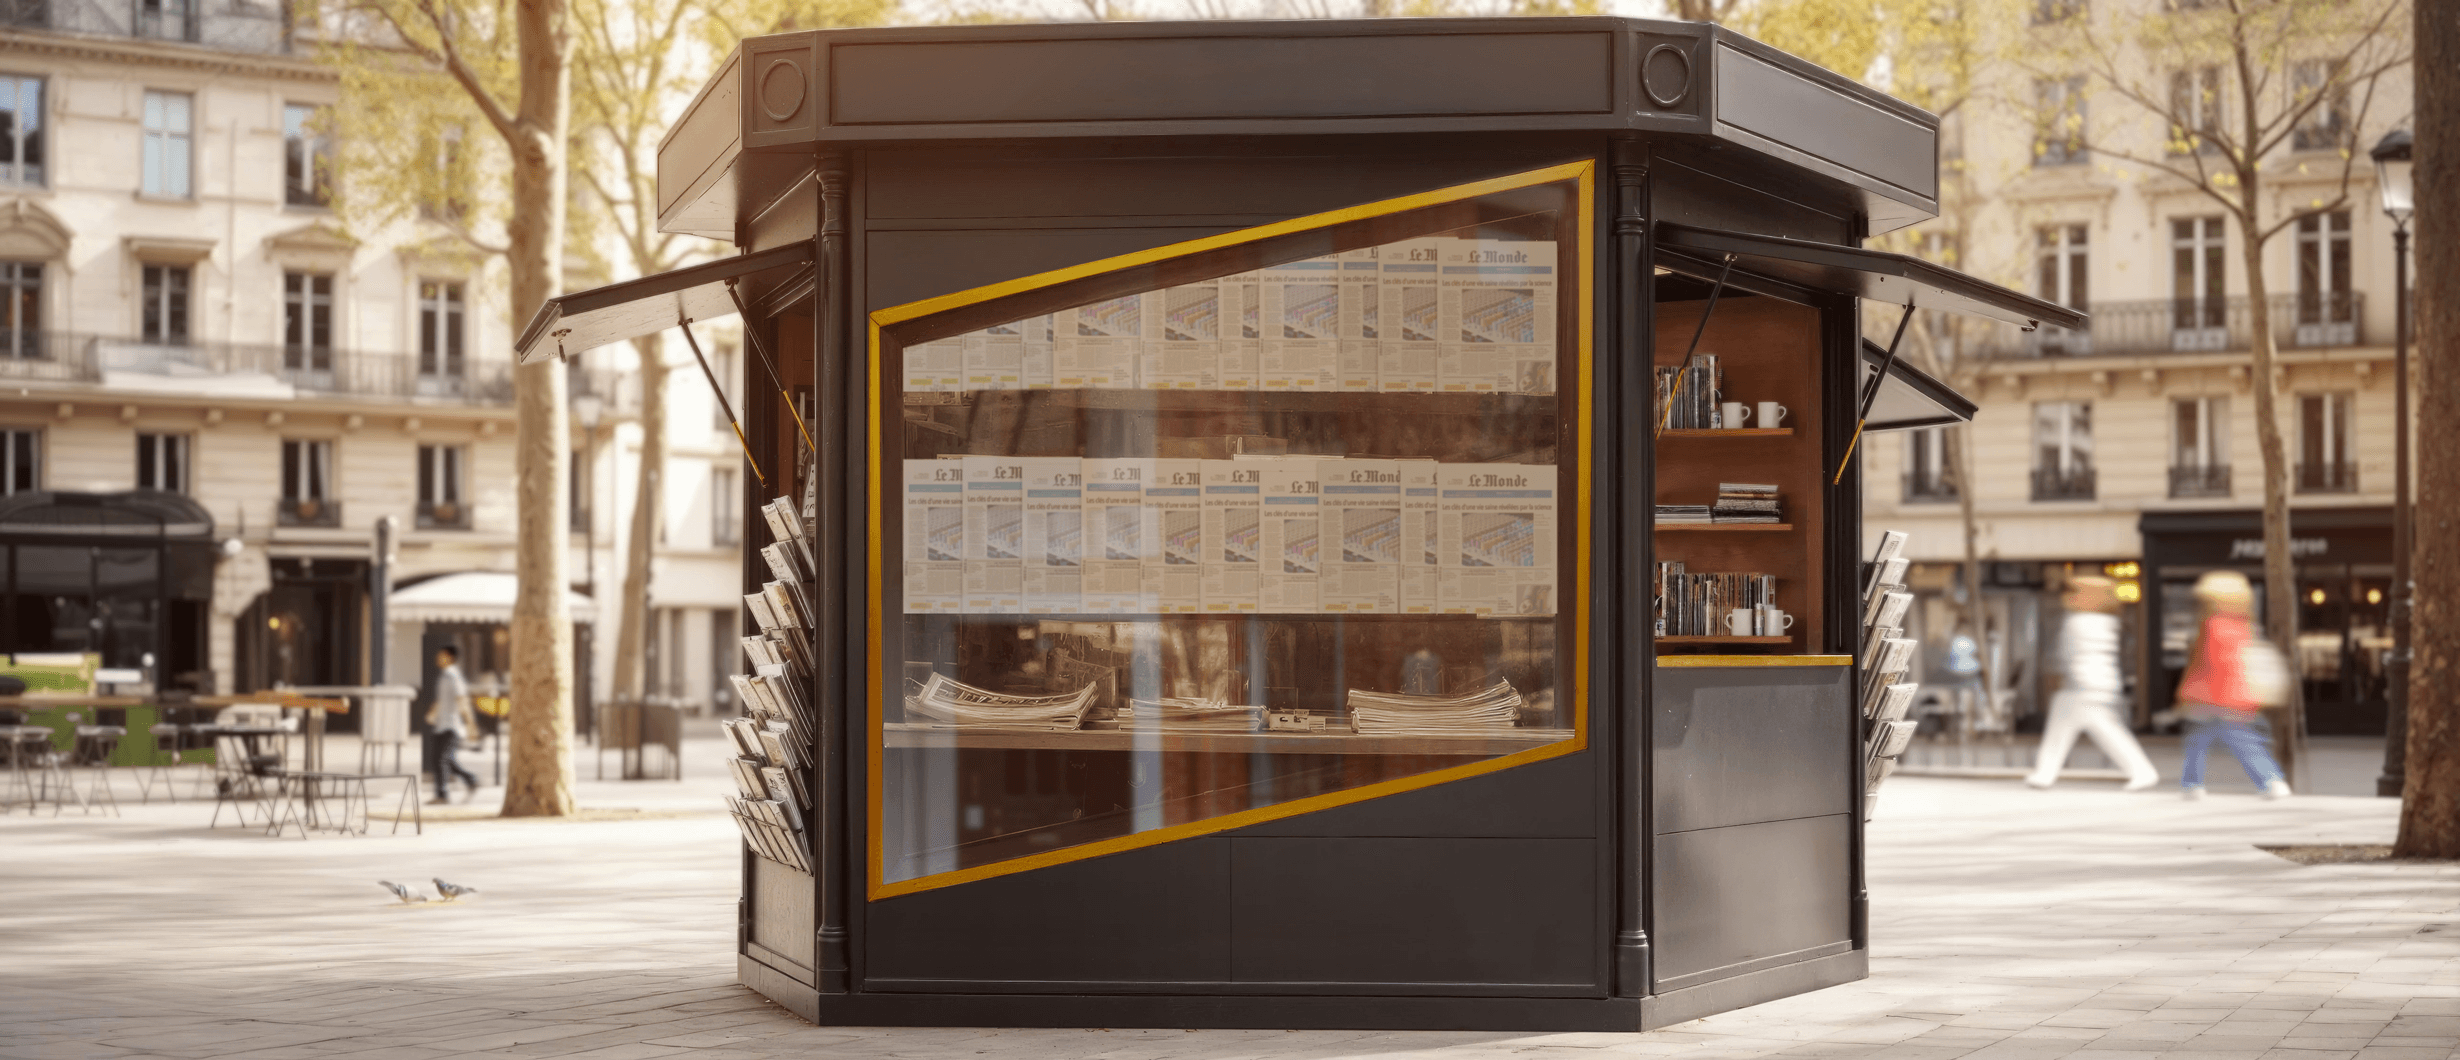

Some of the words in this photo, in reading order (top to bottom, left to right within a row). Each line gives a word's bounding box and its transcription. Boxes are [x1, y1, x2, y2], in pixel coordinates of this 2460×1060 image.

[1408, 248, 1422, 262] Le
[1467, 250, 1481, 264] Le
[1482, 250, 1528, 264] Monde
[1273, 275, 1283, 283] clés
[1283, 275, 1297, 283] d'une
[1298, 275, 1306, 283] vie
[1307, 275, 1320, 283] saine
[1352, 275, 1362, 283] clés
[1392, 277, 1402, 285] clés
[1402, 277, 1416, 285] d'une
[1451, 279, 1461, 287] clés
[1461, 279, 1475, 287] d'une
[1528, 279, 1533, 287] la
[933, 468, 948, 482] Le
[992, 466, 1007, 479] Le
[1111, 467, 1125, 481] Le
[1230, 470, 1244, 483] Le
[1348, 470, 1363, 483] Le
[1052, 473, 1066, 487] Le
[1170, 472, 1185, 485] Le
[1467, 474, 1481, 487] Le
[1482, 474, 1528, 487] Monde
[1289, 480, 1303, 494] Le
[917, 497, 927, 505] clés
[928, 497, 942, 505] d'une
[976, 495, 986, 503] clés
[987, 495, 1001, 503] d'une
[1001, 495, 1009, 503] vie
[1095, 496, 1105, 504] clés
[1105, 496, 1119, 504] d'une
[1205, 499, 1213, 507] Les
[1214, 499, 1224, 507] clés
[1224, 499, 1238, 507] d'une
[1239, 499, 1247, 507] vie
[1323, 499, 1331, 507] Les
[1332, 499, 1342, 507] clés
[1343, 499, 1357, 507] d'une
[1357, 499, 1365, 507] vie
[1366, 499, 1379, 507] saine
[1036, 502, 1046, 510] clés
[1046, 502, 1060, 510] d'une
[1154, 501, 1164, 509] clés
[1165, 501, 1179, 509] d'une
[1179, 501, 1187, 509] vie
[1414, 501, 1424, 509] clés
[1451, 503, 1461, 511] clés
[1461, 503, 1475, 511] d'une
[1476, 503, 1484, 511] vie
[1485, 503, 1498, 511] saine
[1528, 503, 1533, 511] la
[1534, 503, 1552, 511] science
[1273, 509, 1283, 517] clés
[1283, 509, 1297, 517] d'une
